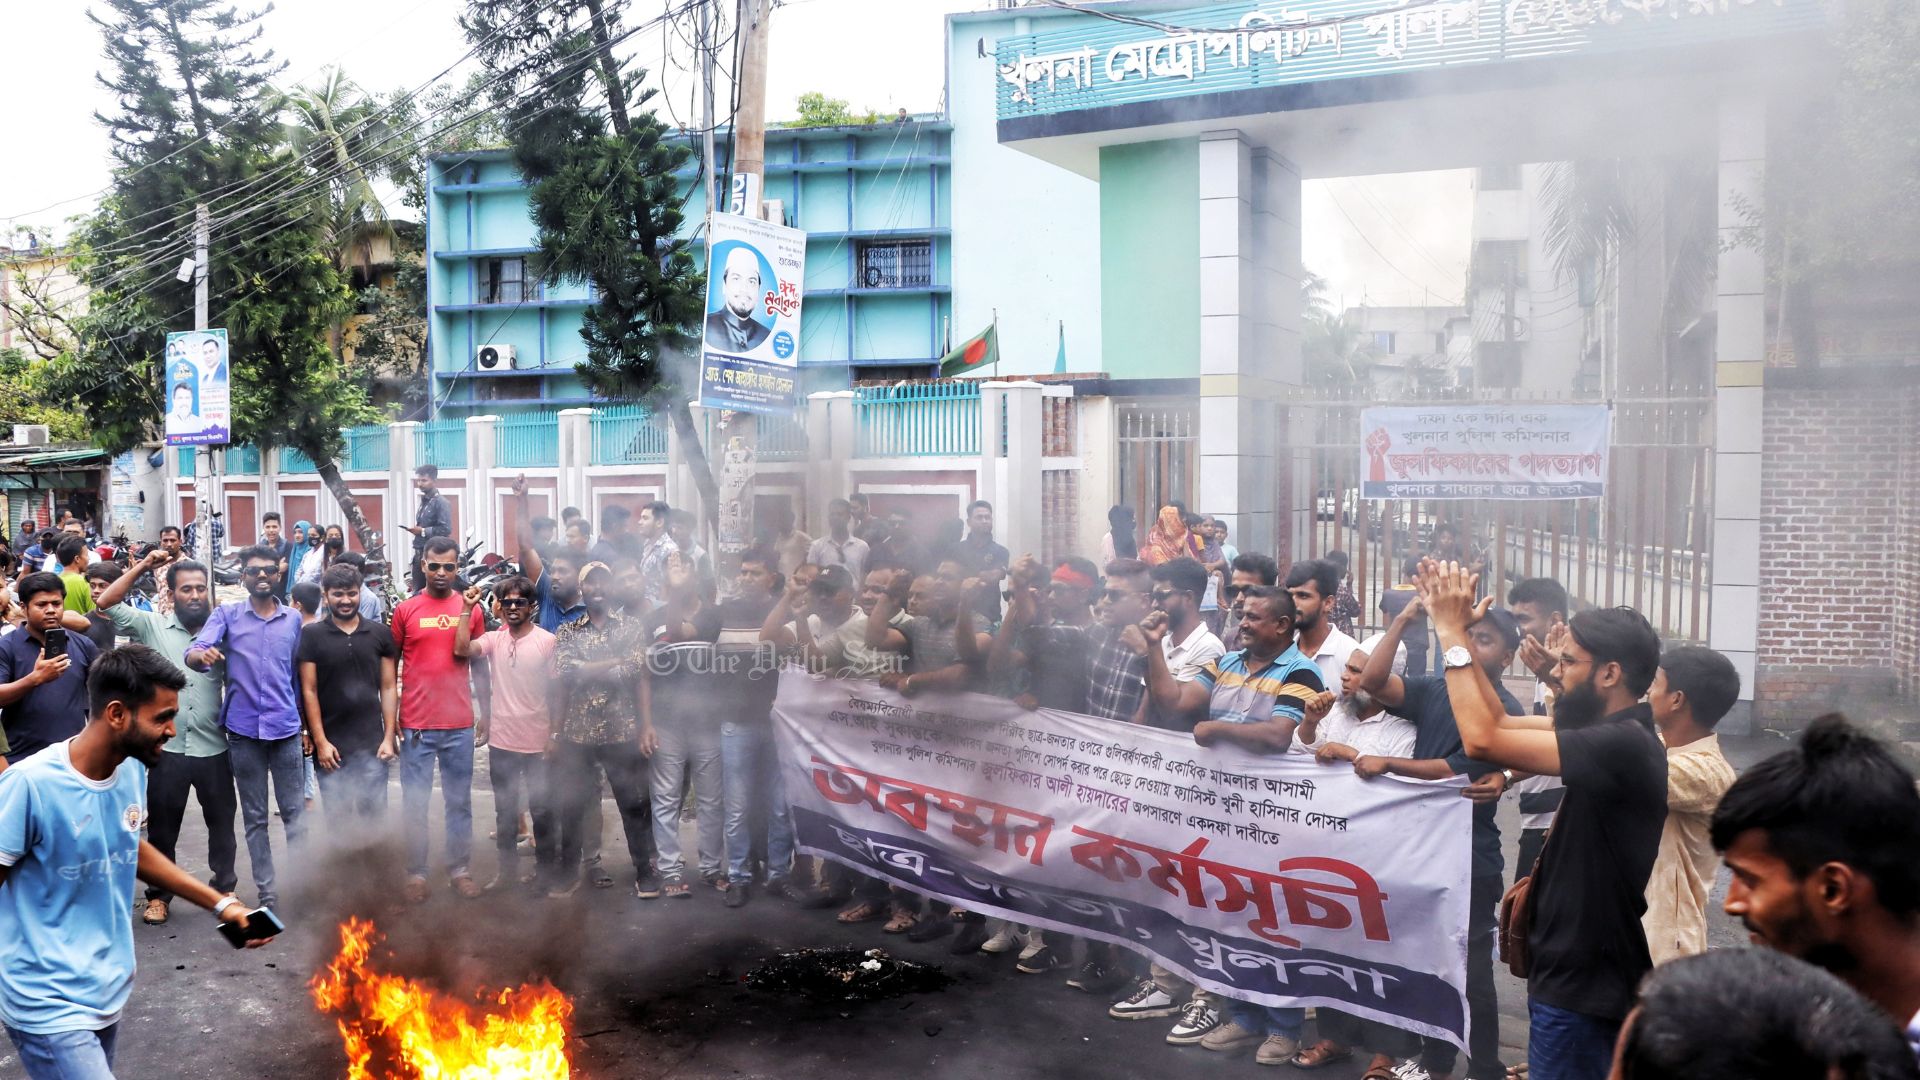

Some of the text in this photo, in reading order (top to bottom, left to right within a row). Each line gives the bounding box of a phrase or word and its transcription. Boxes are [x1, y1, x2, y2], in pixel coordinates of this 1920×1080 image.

[999, 46, 1098, 104] খুলনা
[1362, 0, 1480, 60] পুলিশ
[779, 278, 796, 297] ঈদ
[1402, 427, 1571, 445] খুলনার পুলিশ কমিশনার
[1416, 410, 1548, 425] দফা এক দাবি এক
[1387, 483, 1582, 498] খুলনার সাধারণ ছাত্র জনতা
[1388, 447, 1602, 481] জুলফিকারের পদত্যাগ
[848, 695, 913, 720] বৈষম্যবিরোধী
[999, 721, 1026, 741] নিরীহ
[1028, 727, 1076, 751] ছাত্র-জনতার
[1078, 740, 1102, 757] ওপরে
[1105, 742, 1164, 771] গুলিবর্ষণকারী
[1165, 758, 1207, 780] একাধিক
[1210, 769, 1259, 790] মামলার
[1264, 778, 1317, 801] আসামী
[884, 720, 944, 743] সুকান্তকে
[1014, 746, 1042, 765] পুলিশে
[1043, 754, 1069, 774] সোপর্দ
[1070, 759, 1091, 777] করার
[1093, 766, 1109, 781] পরে
[1110, 771, 1132, 788] ছেড়ে
[1134, 776, 1171, 798] দেওয়ায়
[1174, 784, 1218, 807] ফ্যাসিস্ট
[1222, 793, 1245, 817] খুনী
[1249, 797, 1301, 824] হাসিনার
[1305, 811, 1349, 832] দোসর
[905, 745, 933, 763] পুলিশ
[935, 750, 977, 771] কমিশনার
[981, 762, 1043, 789] জুলফিকার
[1046, 774, 1073, 798] আলী
[1076, 783, 1130, 814] হায়দারের
[1132, 800, 1182, 826] অপসারণে
[1186, 816, 1232, 838] একদফা
[1235, 822, 1281, 846] দাবীতে
[810, 755, 1392, 951] অবস্থান কর্মসূচী
[1177, 929, 1400, 999] খুলনা
